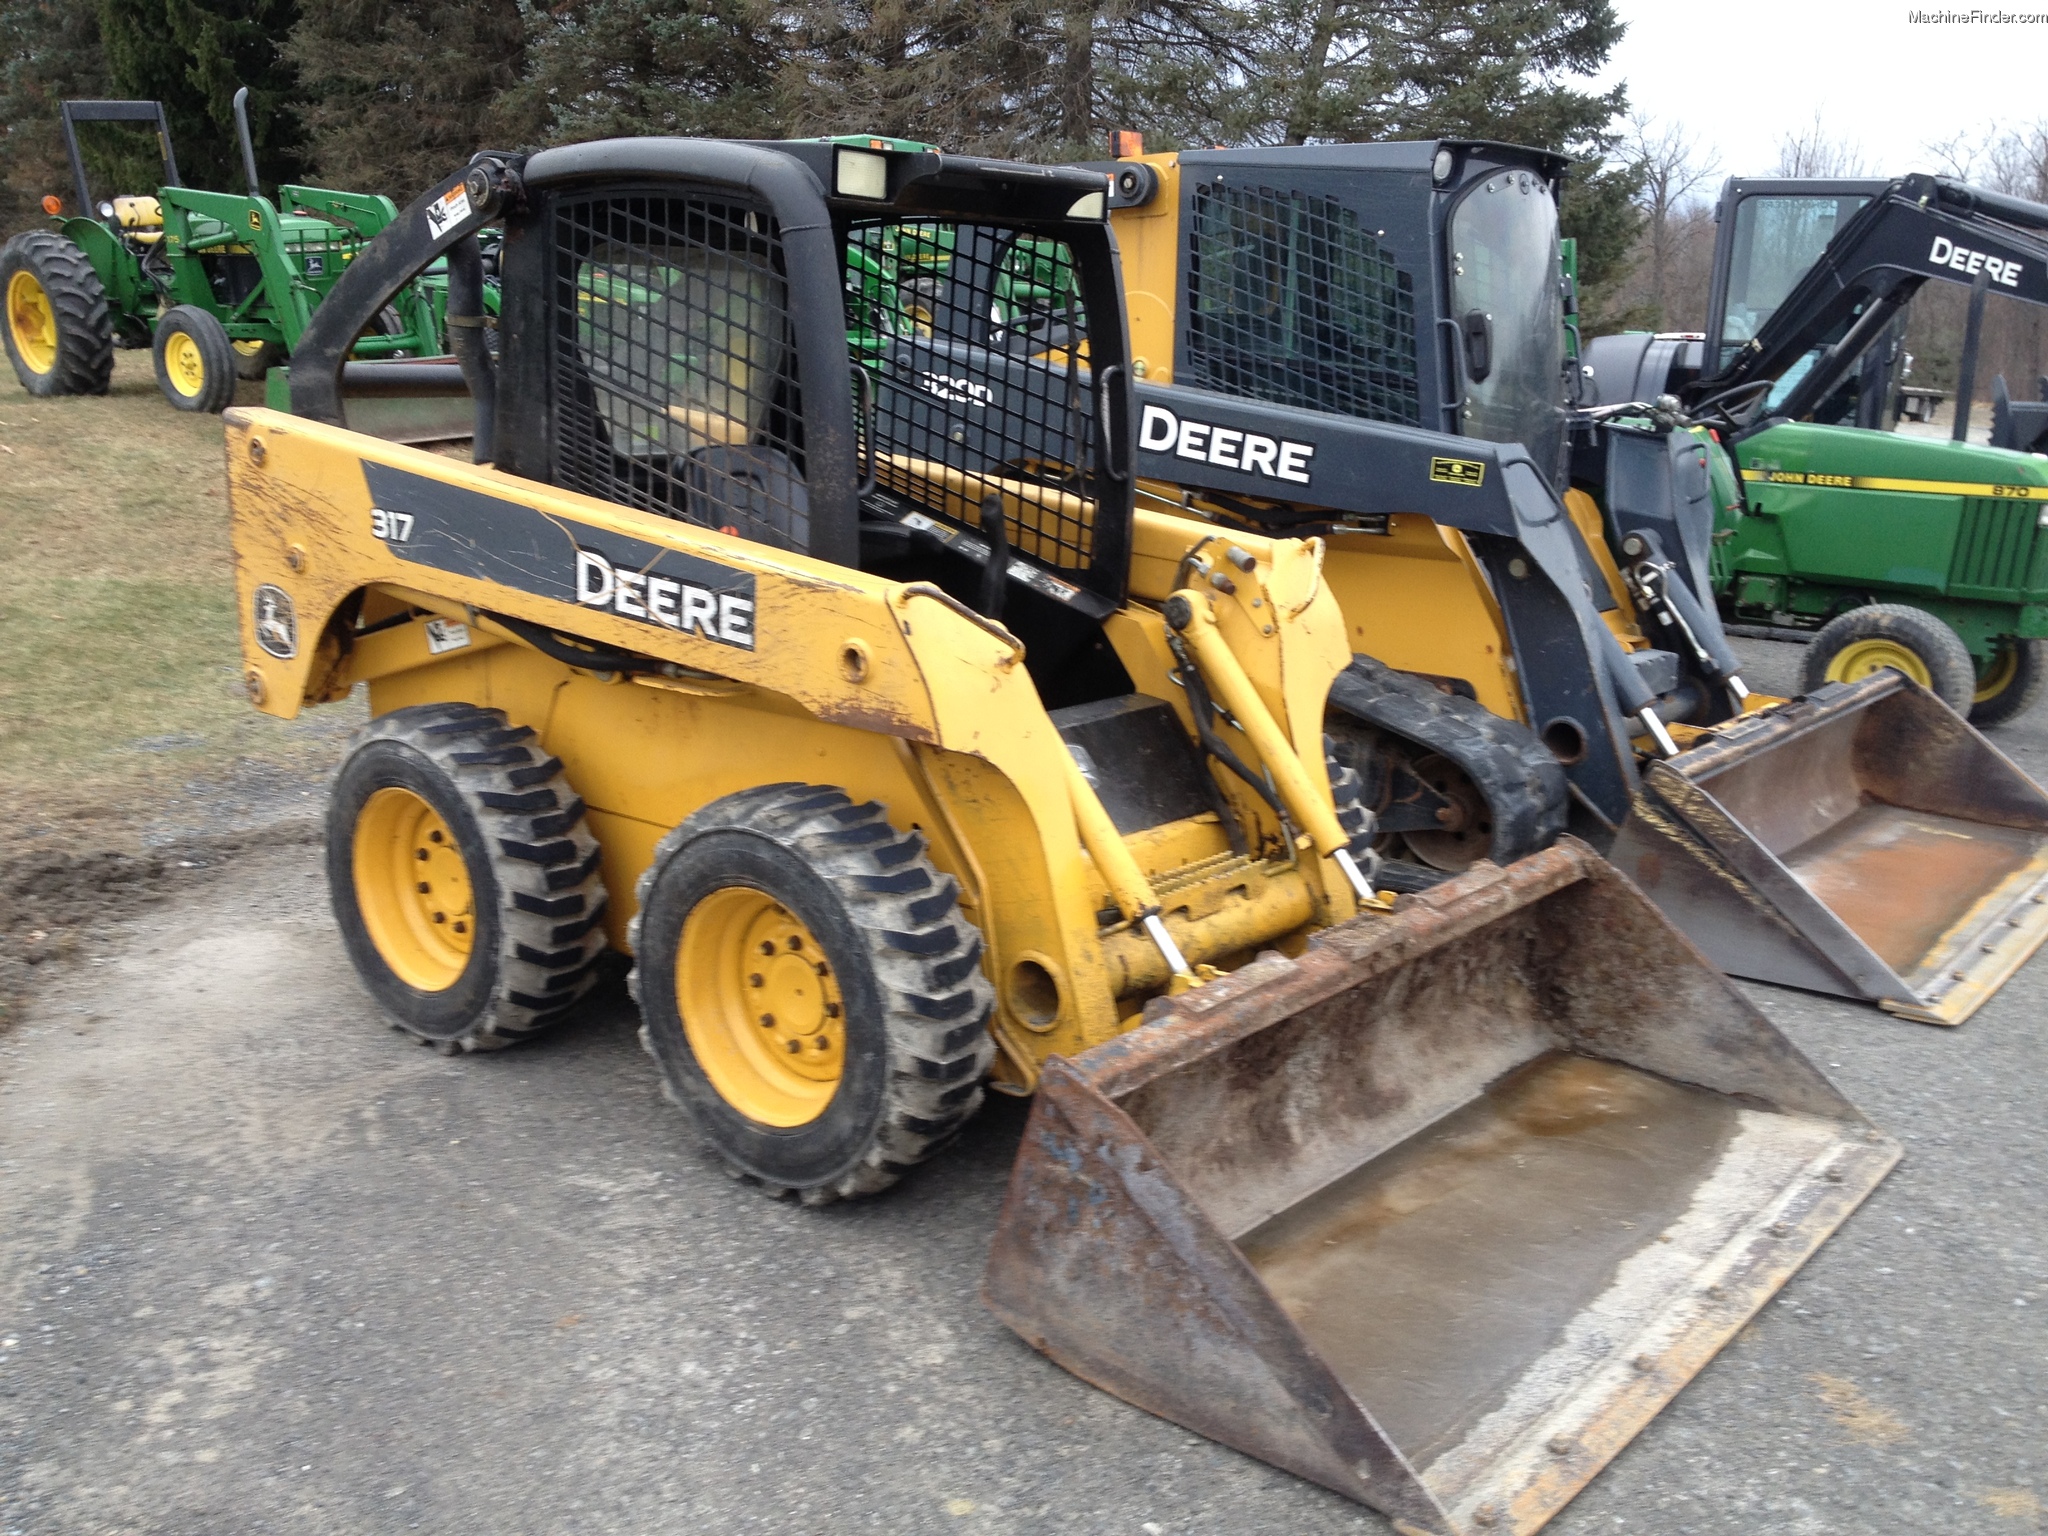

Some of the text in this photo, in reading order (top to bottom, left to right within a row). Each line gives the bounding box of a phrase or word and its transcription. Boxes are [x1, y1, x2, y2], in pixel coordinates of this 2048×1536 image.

[1928, 235, 2023, 288] DEERE
[1138, 404, 1314, 484] DEERE
[1768, 471, 1852, 487] JOHN DEERE
[1992, 485, 2030, 497] 870
[370, 508, 415, 542] 317
[576, 549, 754, 647] DEERE
